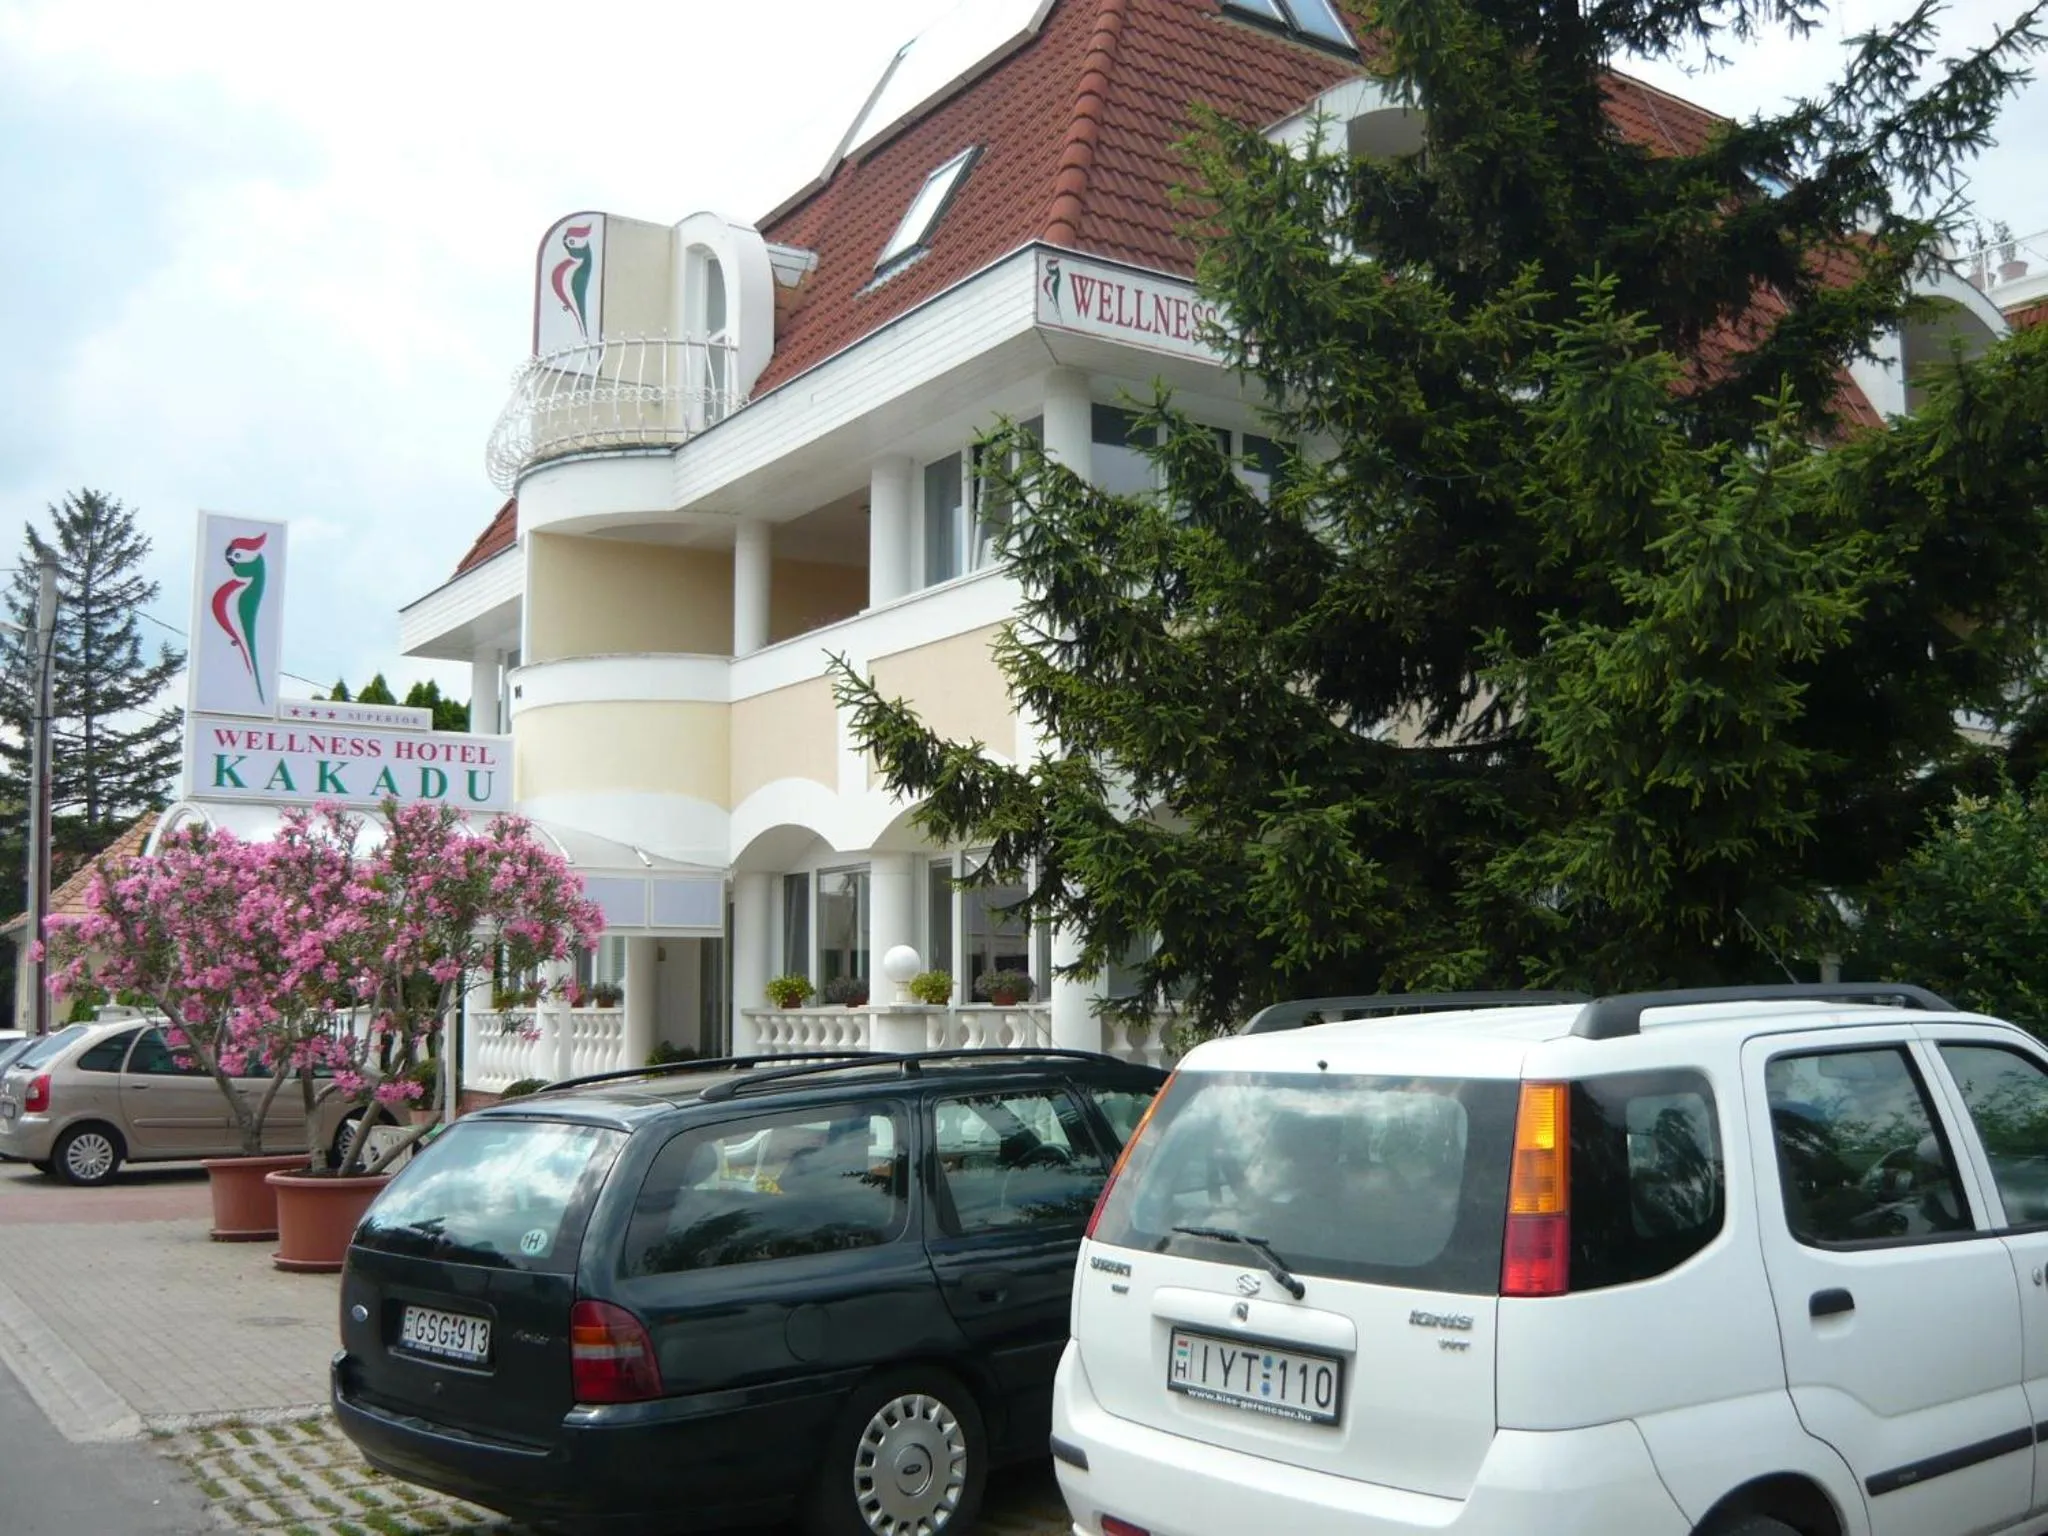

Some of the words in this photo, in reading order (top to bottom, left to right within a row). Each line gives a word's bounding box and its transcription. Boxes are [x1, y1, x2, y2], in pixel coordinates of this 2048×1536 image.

[1069, 273, 1217, 347] WELLNESS
[214, 728, 382, 757] WELLNESS
[395, 741, 496, 765] HOTEL
[211, 753, 495, 801] KAKADU
